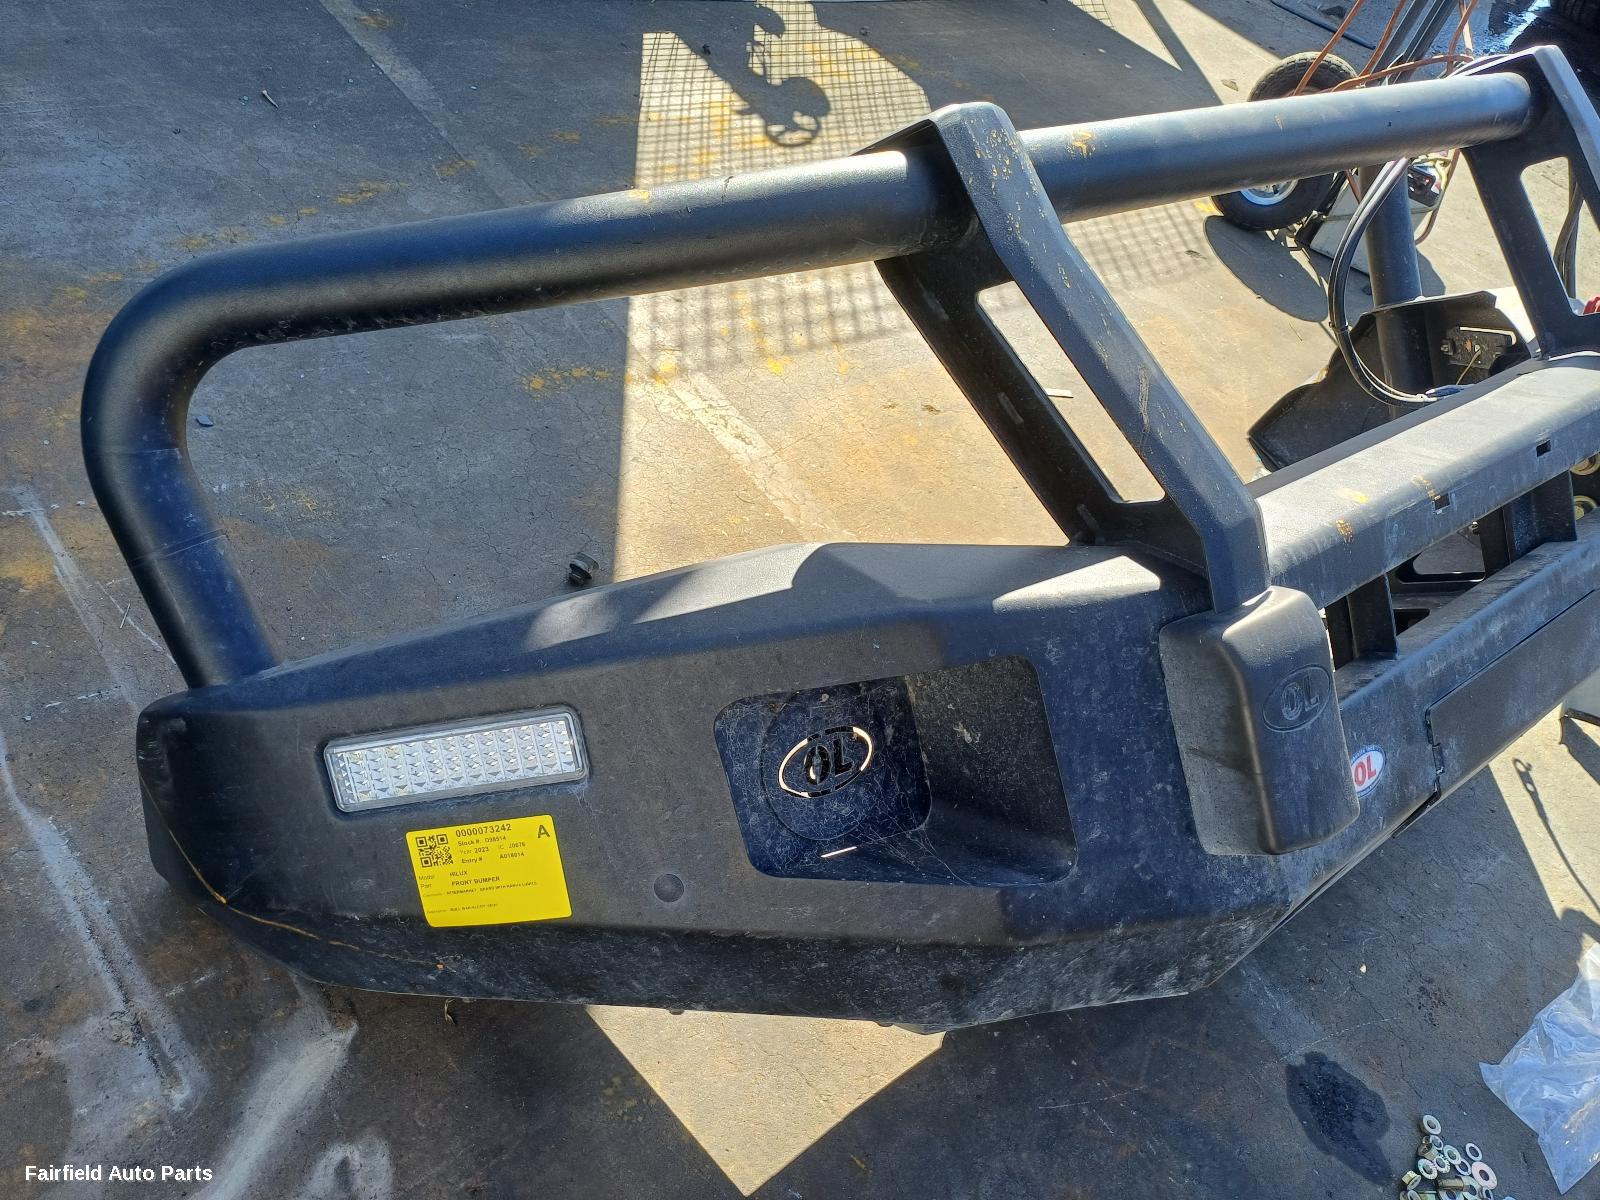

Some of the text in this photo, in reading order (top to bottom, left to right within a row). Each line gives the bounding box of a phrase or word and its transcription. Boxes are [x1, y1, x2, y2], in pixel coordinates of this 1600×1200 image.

[1281, 674, 1320, 720] OL
[804, 739, 854, 785] OL
[1354, 755, 1377, 786] OL
[455, 823, 512, 838] 0000073242
[537, 824, 551, 839] A
[474, 846, 489, 854] 2023
[462, 857, 478, 865] Entry
[451, 878, 473, 887] FRONT
[473, 876, 500, 884] BUMPER
